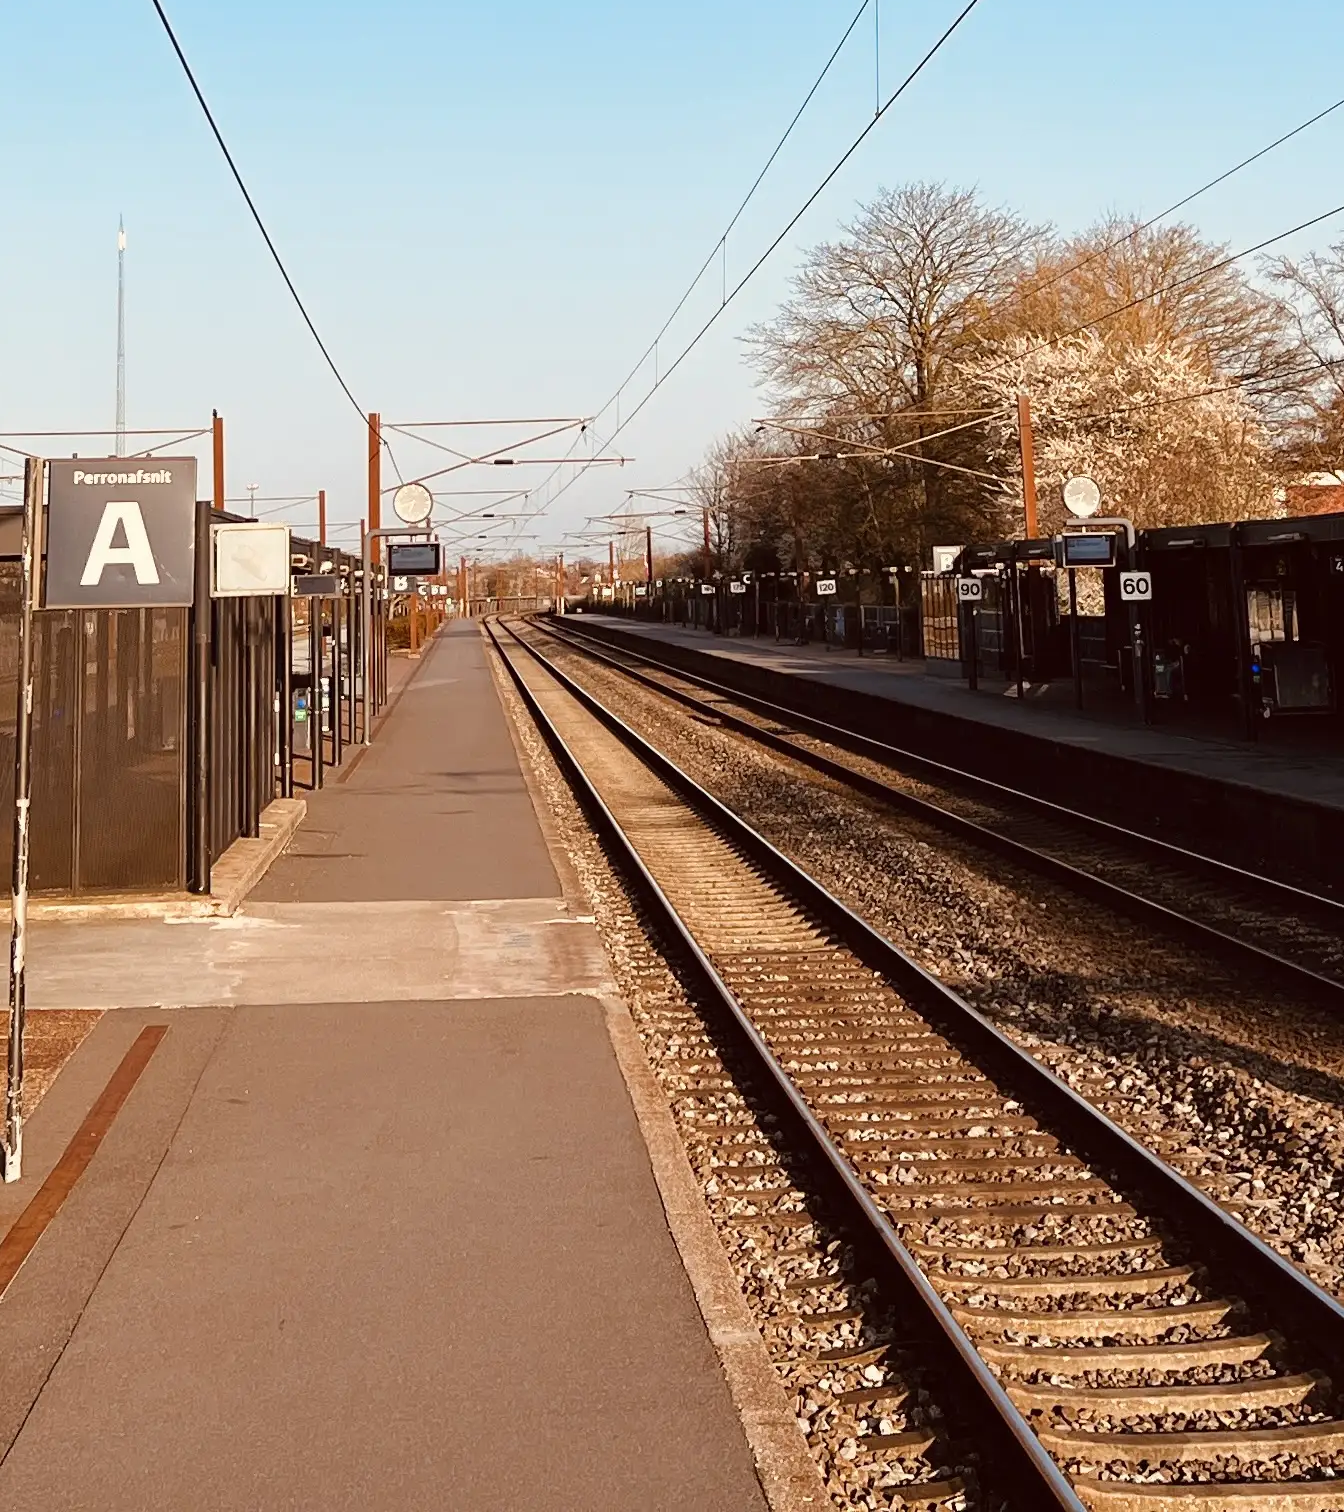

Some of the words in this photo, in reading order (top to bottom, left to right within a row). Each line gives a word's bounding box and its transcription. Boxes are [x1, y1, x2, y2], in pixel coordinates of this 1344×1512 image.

[72, 469, 172, 487] Perronafsnit
[79, 501, 160, 586] A
[960, 583, 980, 596] 90
[1123, 577, 1149, 595] 60
